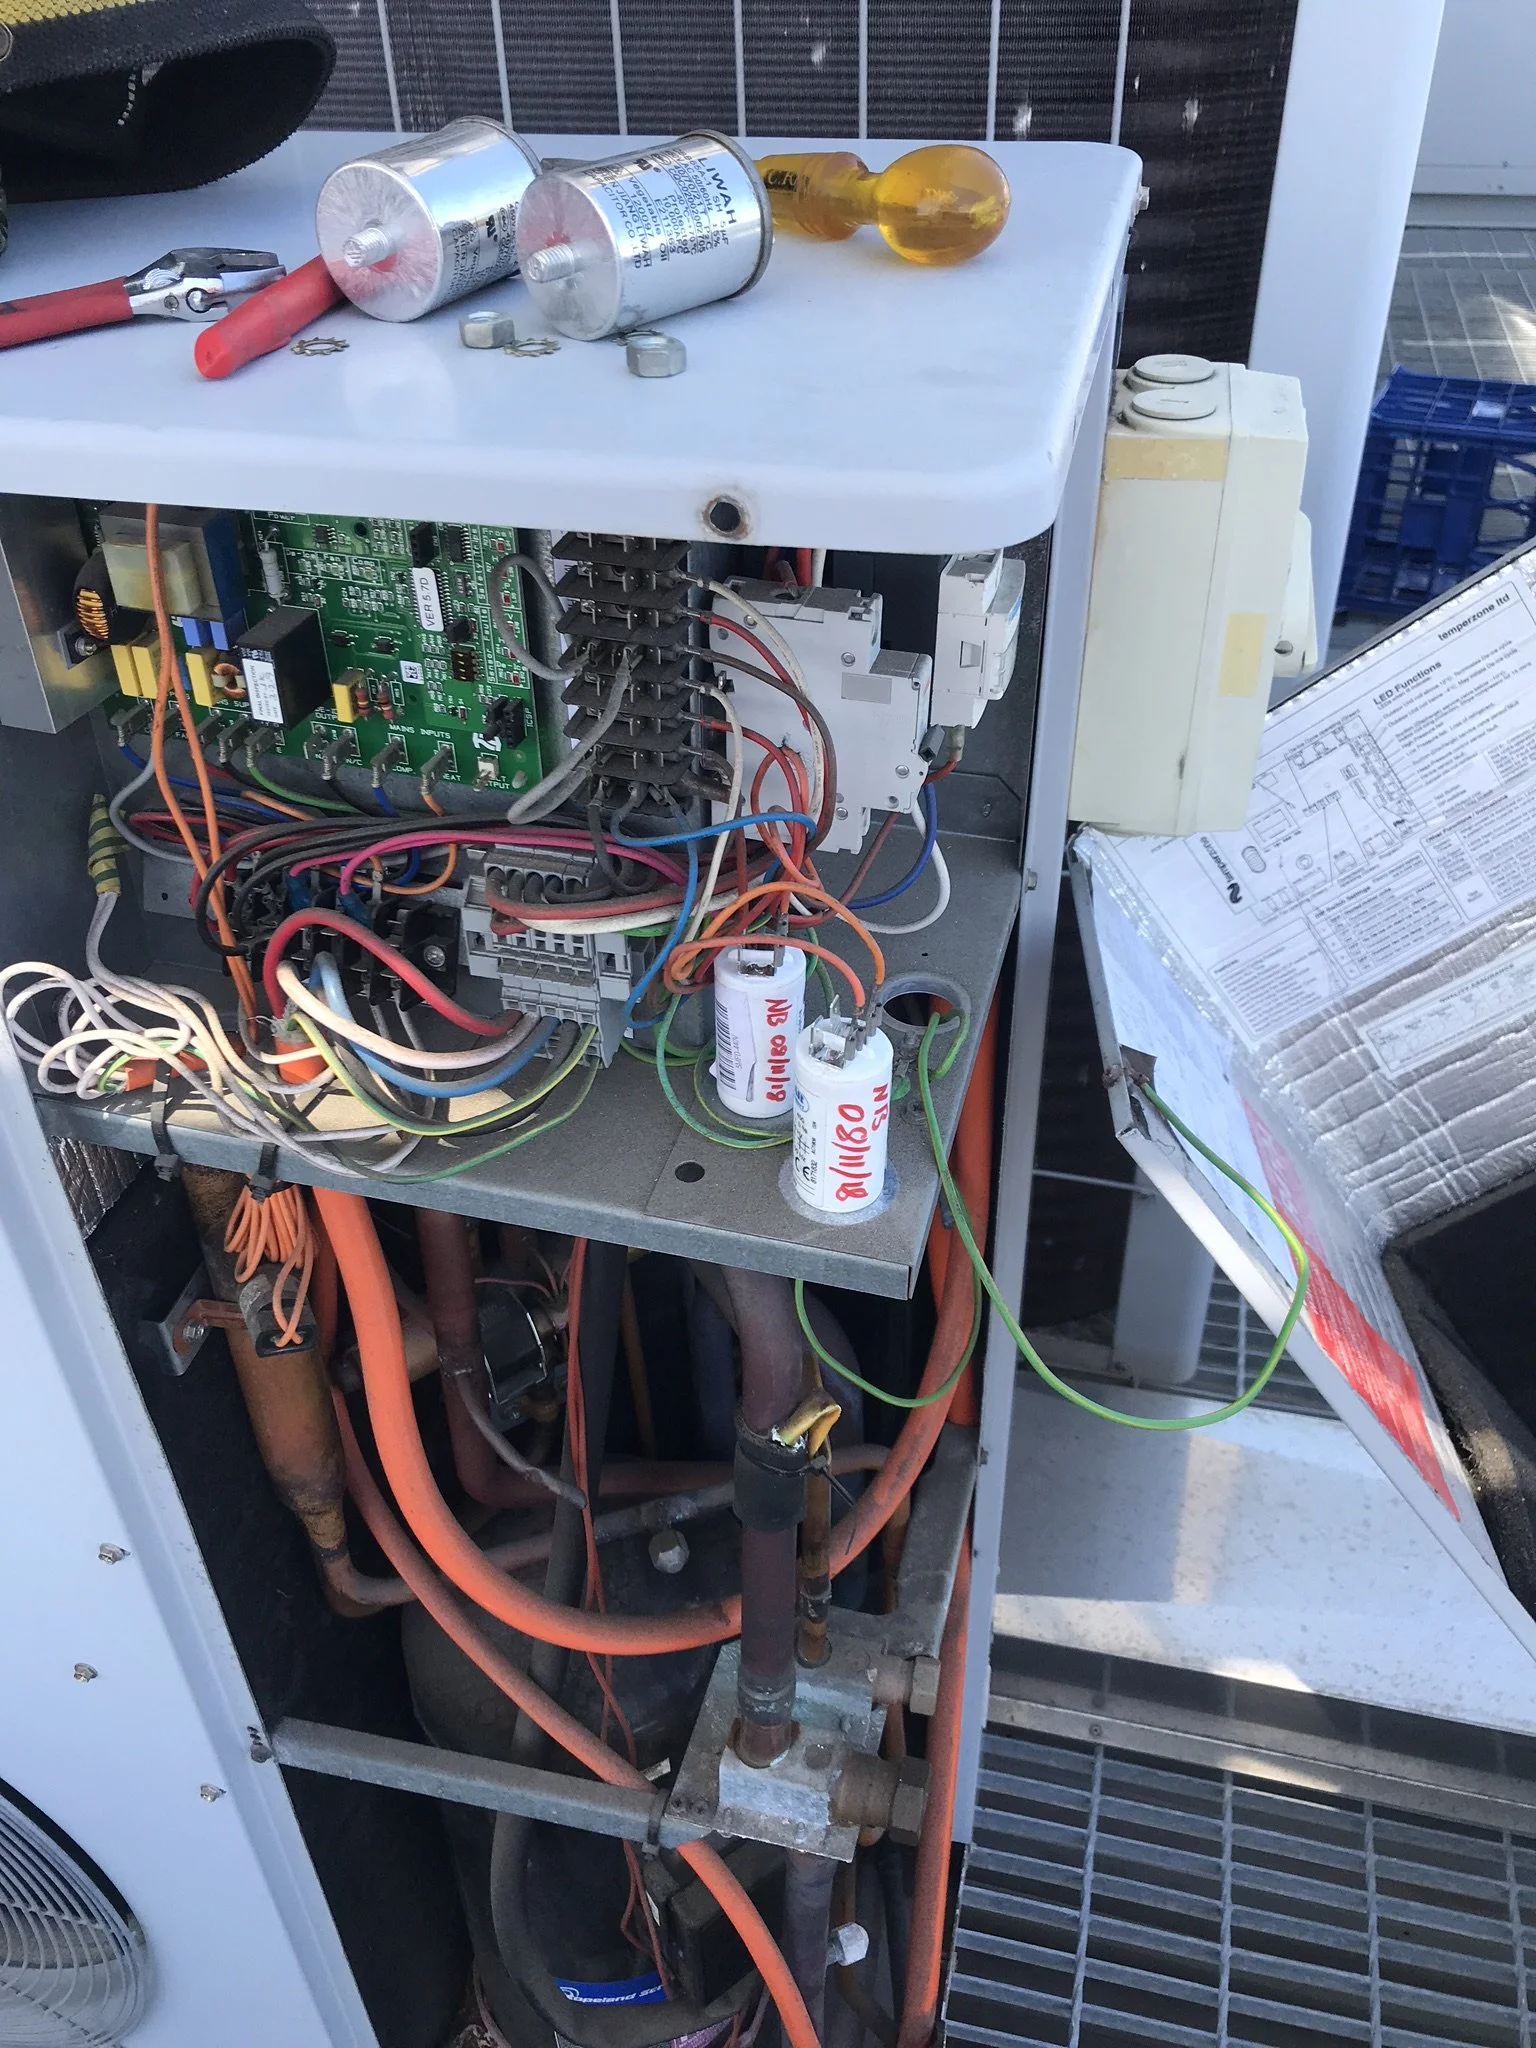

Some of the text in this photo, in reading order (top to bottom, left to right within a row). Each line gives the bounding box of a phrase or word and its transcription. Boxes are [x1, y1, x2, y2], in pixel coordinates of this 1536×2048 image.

[629, 177, 661, 235] Vegetable
[698, 157, 738, 224] LIWAH
[616, 188, 640, 222] JIANG
[636, 227, 652, 268] LIWAH
[667, 194, 690, 254] Protected
[482, 527, 513, 538] Frost
[474, 562, 486, 600] Safety
[424, 610, 437, 627] VER
[1437, 592, 1510, 641] temperzone ltd
[486, 649, 497, 683] Sensor
[1372, 659, 1442, 705] LED Functions
[388, 724, 451, 739] MAINS INPUTS
[524, 707, 534, 728] ICSP
[764, 998, 793, 1027] NB
